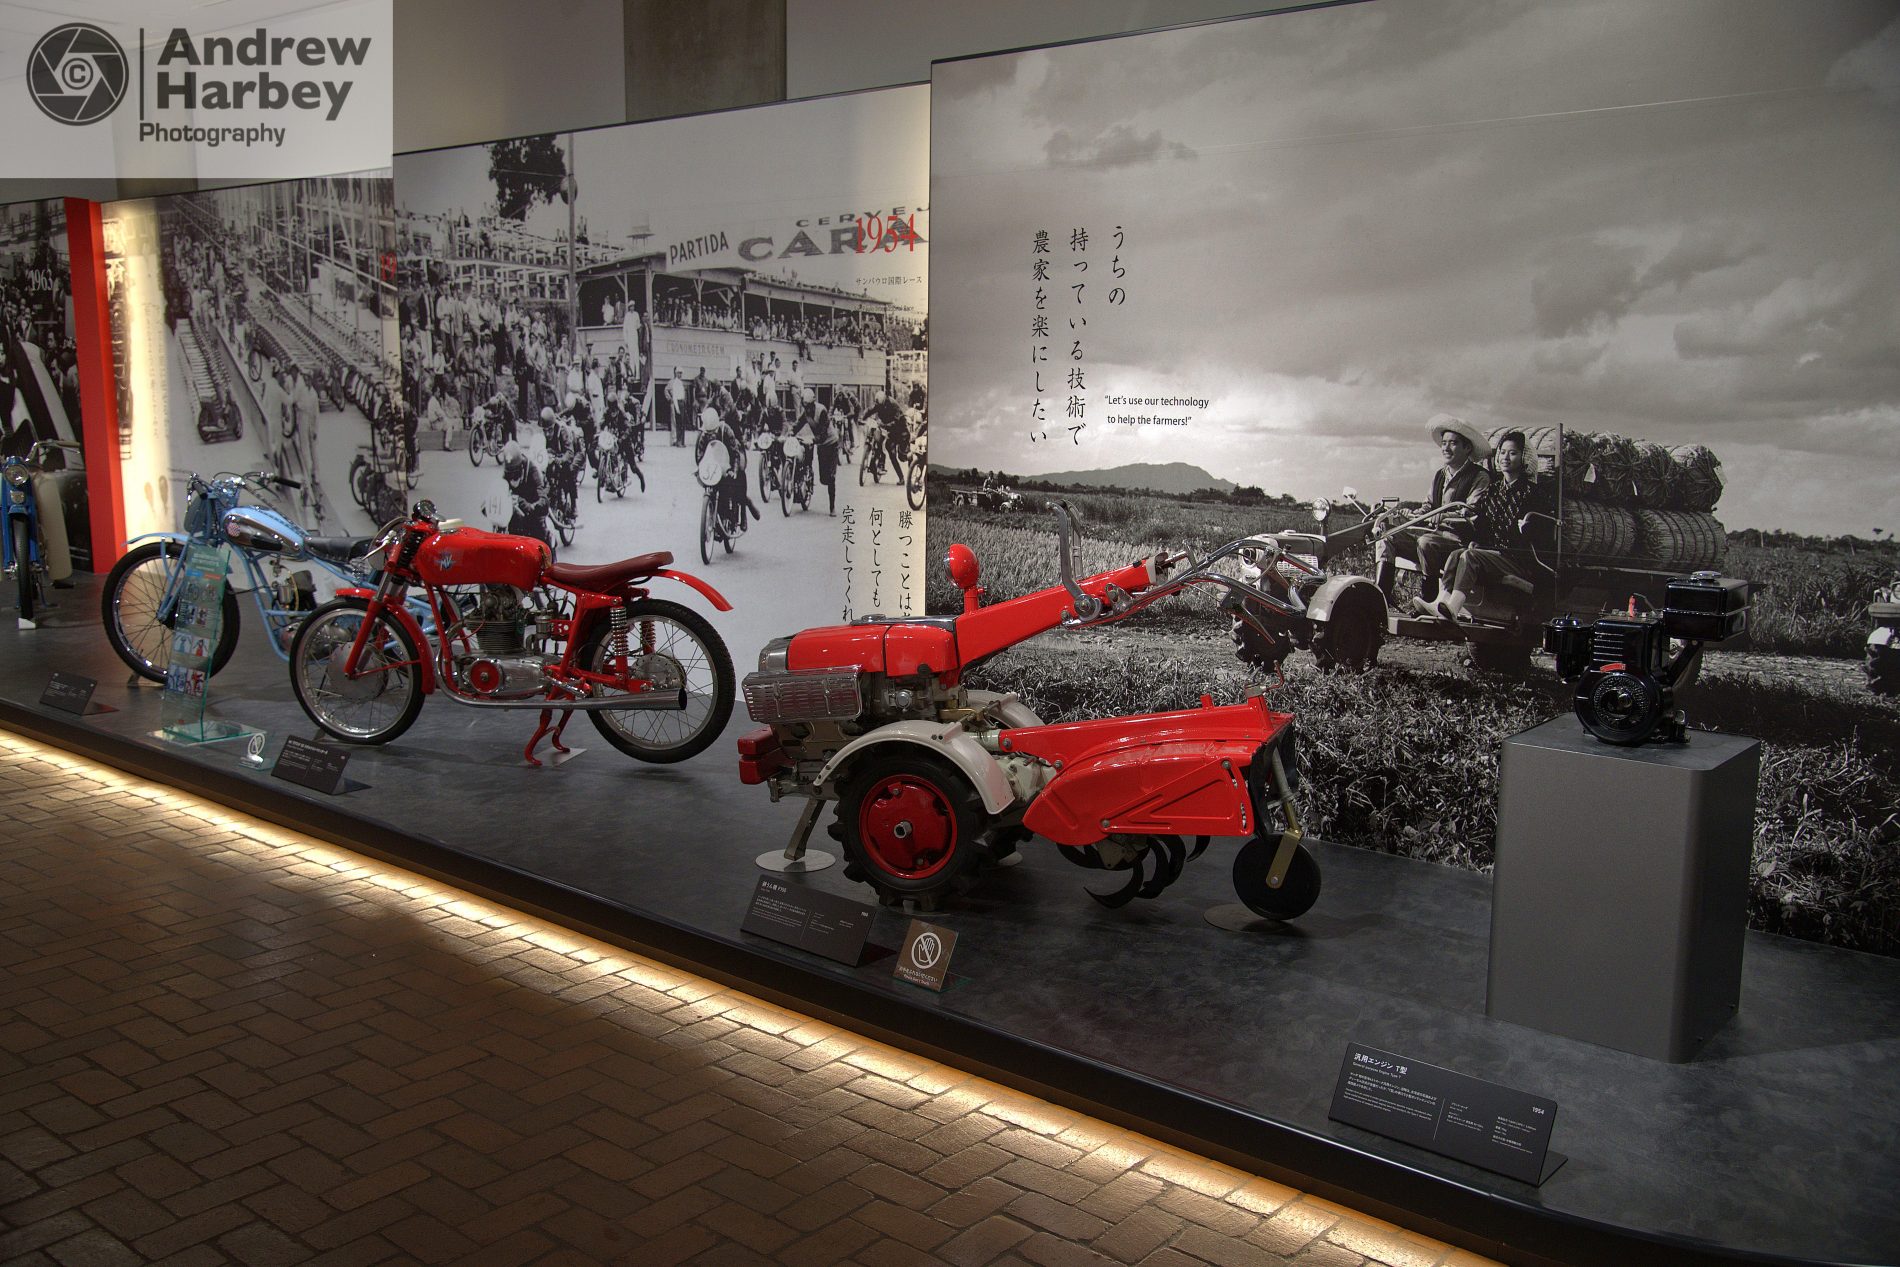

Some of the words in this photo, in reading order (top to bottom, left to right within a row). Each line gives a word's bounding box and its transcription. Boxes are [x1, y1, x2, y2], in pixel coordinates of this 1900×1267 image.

[669, 231, 730, 265] PARTIDA
[855, 213, 919, 254] 1954
[1108, 226, 1126, 306] うちの
[1030, 229, 1051, 443] 農家を楽にしたい
[1066, 227, 1089, 445] 持っている技術で
[1107, 415, 1116, 424] to
[1117, 414, 1136, 426] help
[1137, 415, 1152, 425] the
[1144, 398, 1160, 406] our
[1160, 396, 1210, 409] technology
[869, 507, 883, 608] 何としても
